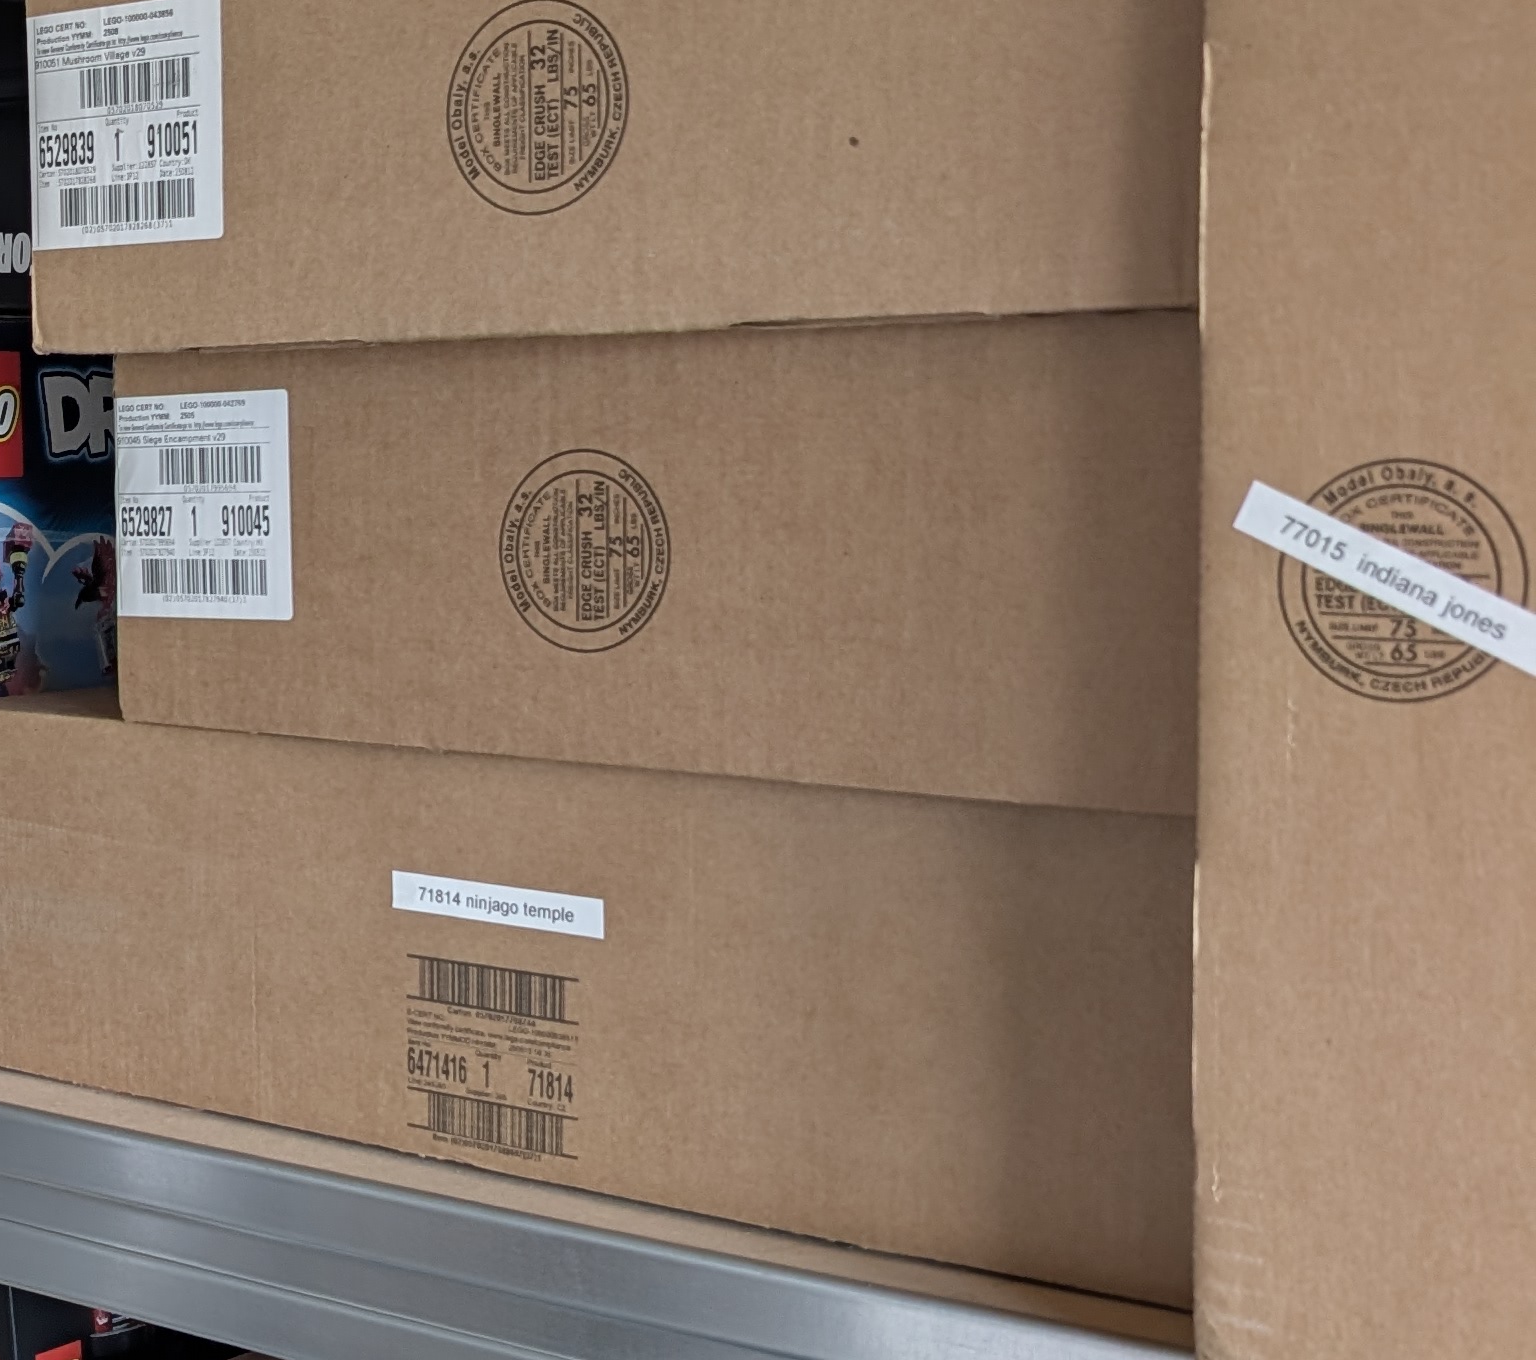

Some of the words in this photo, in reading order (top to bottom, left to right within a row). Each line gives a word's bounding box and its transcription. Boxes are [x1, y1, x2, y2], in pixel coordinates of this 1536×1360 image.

[62, 52, 102, 67] Mushroom
[104, 49, 130, 63] Village
[530, 44, 546, 71] 32
[547, 28, 562, 83] LBS/IN
[572, 13, 618, 70] REPUBLIC
[534, 84, 546, 136] CRUSH
[563, 86, 578, 110] 75
[582, 83, 596, 107] 65
[611, 71, 623, 122] CZECH
[39, 130, 95, 169] 6529839
[147, 120, 198, 158] 910051
[456, 136, 480, 180] Model
[534, 140, 546, 181] EDGE
[547, 143, 560, 180] TEST
[578, 493, 593, 518] 32
[593, 481, 608, 531] LBS/IN
[618, 468, 660, 526] REPUBLIC
[121, 505, 173, 538] 6529827
[221, 504, 270, 537] 910045
[581, 531, 593, 580] CRUSH
[608, 535, 623, 559] 75
[626, 535, 640, 559] 65
[654, 528, 665, 575] CZECH
[1278, 514, 1348, 563] 77015
[1354, 554, 1439, 608] indiana
[1438, 595, 1509, 642] jones
[581, 584, 593, 621] EDGE
[593, 586, 605, 622] TEST
[1315, 593, 1355, 612] TEST
[1389, 619, 1419, 638] 75
[1389, 644, 1419, 663] 65
[1369, 676, 1430, 694] CZECH
[418, 884, 462, 909] 71814
[465, 891, 520, 919] ninjago
[522, 900, 576, 927] temple
[407, 1046, 468, 1085] 6471416
[528, 1067, 574, 1104] 71814
